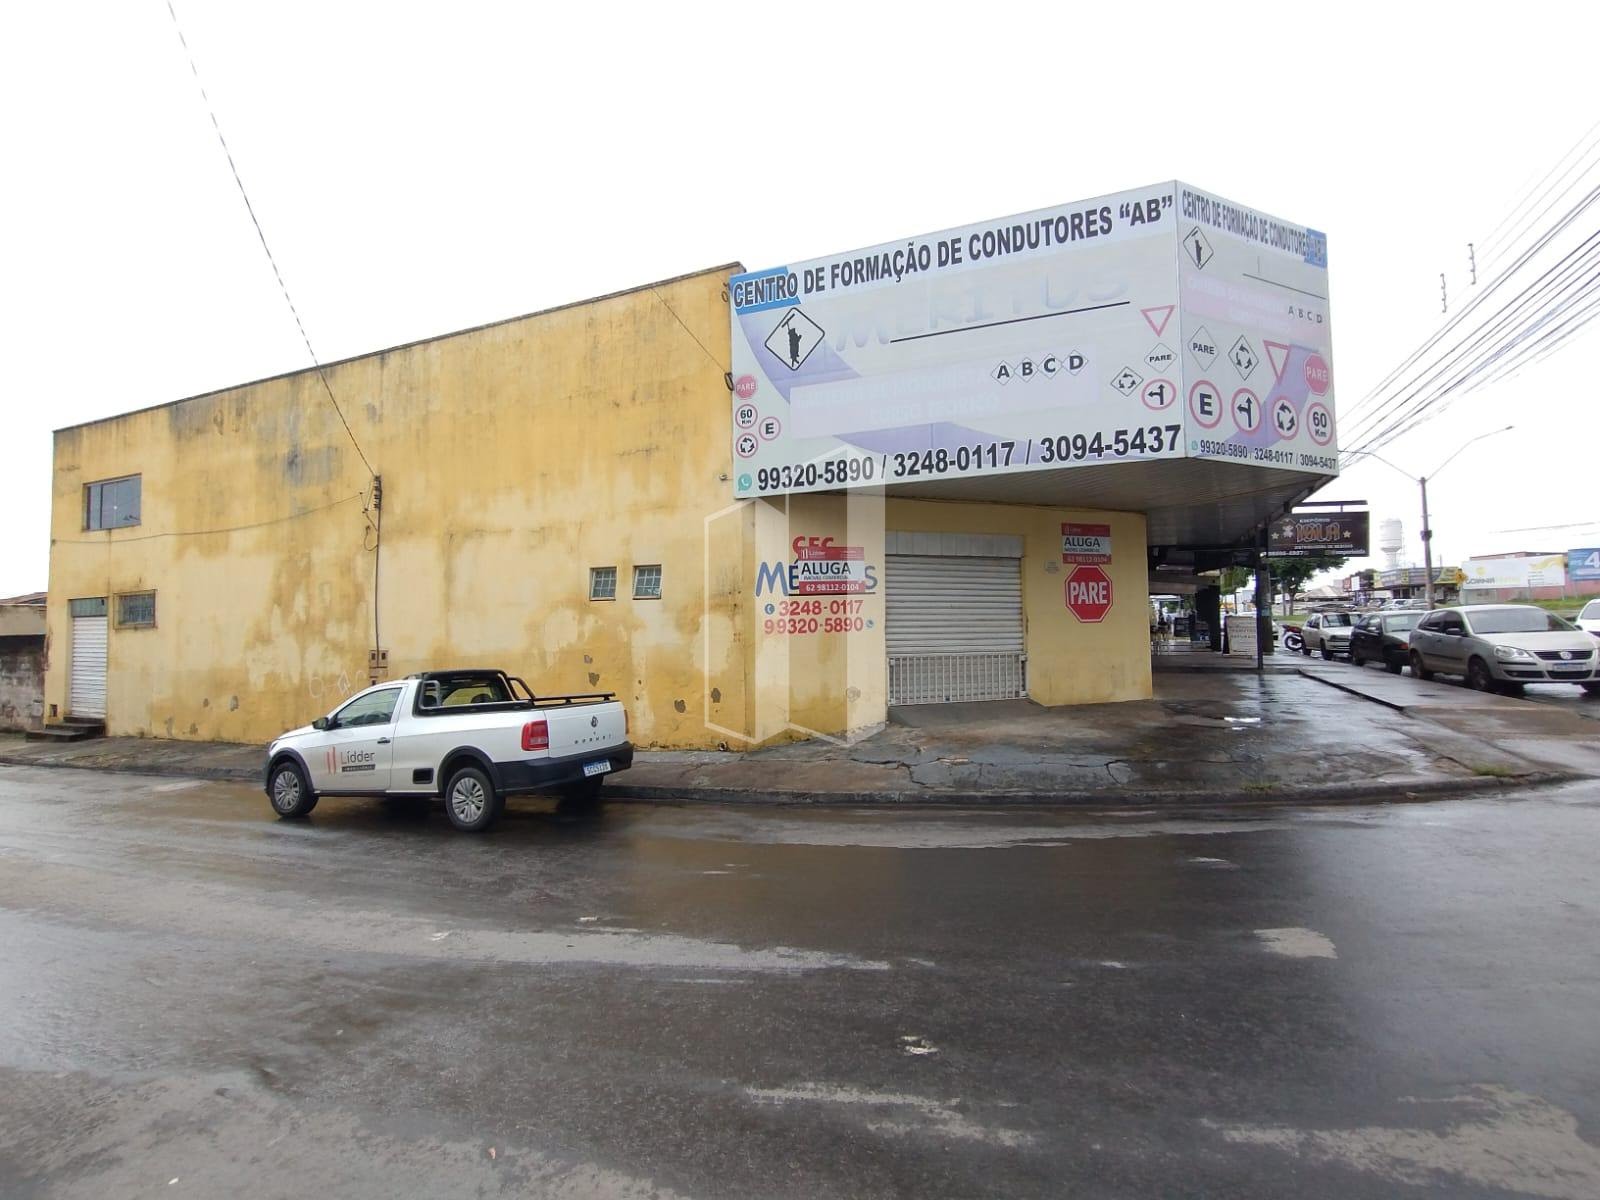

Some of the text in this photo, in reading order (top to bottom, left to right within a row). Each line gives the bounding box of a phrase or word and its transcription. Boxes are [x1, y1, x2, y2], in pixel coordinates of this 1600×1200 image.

[1182, 190, 1210, 224] CENTRO
[1212, 200, 1222, 227] DE
[1222, 208, 1258, 243] FORMAÇÃO
[1259, 217, 1269, 244] DE
[734, 272, 797, 308] CENTRO
[803, 267, 825, 294] DE
[831, 242, 931, 286] FORMAÇÃO
[938, 237, 962, 267] DE
[968, 206, 1112, 260] CONDUTORES
[1288, 306, 1294, 315] A
[1307, 311, 1313, 321] C
[1316, 314, 1323, 323] D
[1193, 342, 1214, 354] PARE
[1149, 353, 1172, 362] PARE
[997, 355, 1084, 379] A B C D
[1306, 365, 1328, 382] PARE
[736, 382, 755, 392] PARE
[1199, 393, 1213, 416] E
[740, 409, 753, 420] 60
[1312, 411, 1327, 428] 60
[765, 423, 775, 435] E
[758, 457, 874, 491] 99320-5890
[894, 441, 1015, 476] 3248-0117
[1040, 424, 1181, 463] 3094-5437
[1200, 440, 1248, 458] 99320-5890
[1254, 448, 1293, 465] 3248-0117
[1300, 454, 1337, 470] 3094-5437
[1064, 537, 1101, 547] ALUGA
[801, 562, 851, 575] ALUGA
[806, 584, 816, 592] 62
[1069, 582, 1108, 605] PARE
[779, 600, 864, 616] 3248-0117
[764, 617, 864, 634] 99320-5890
